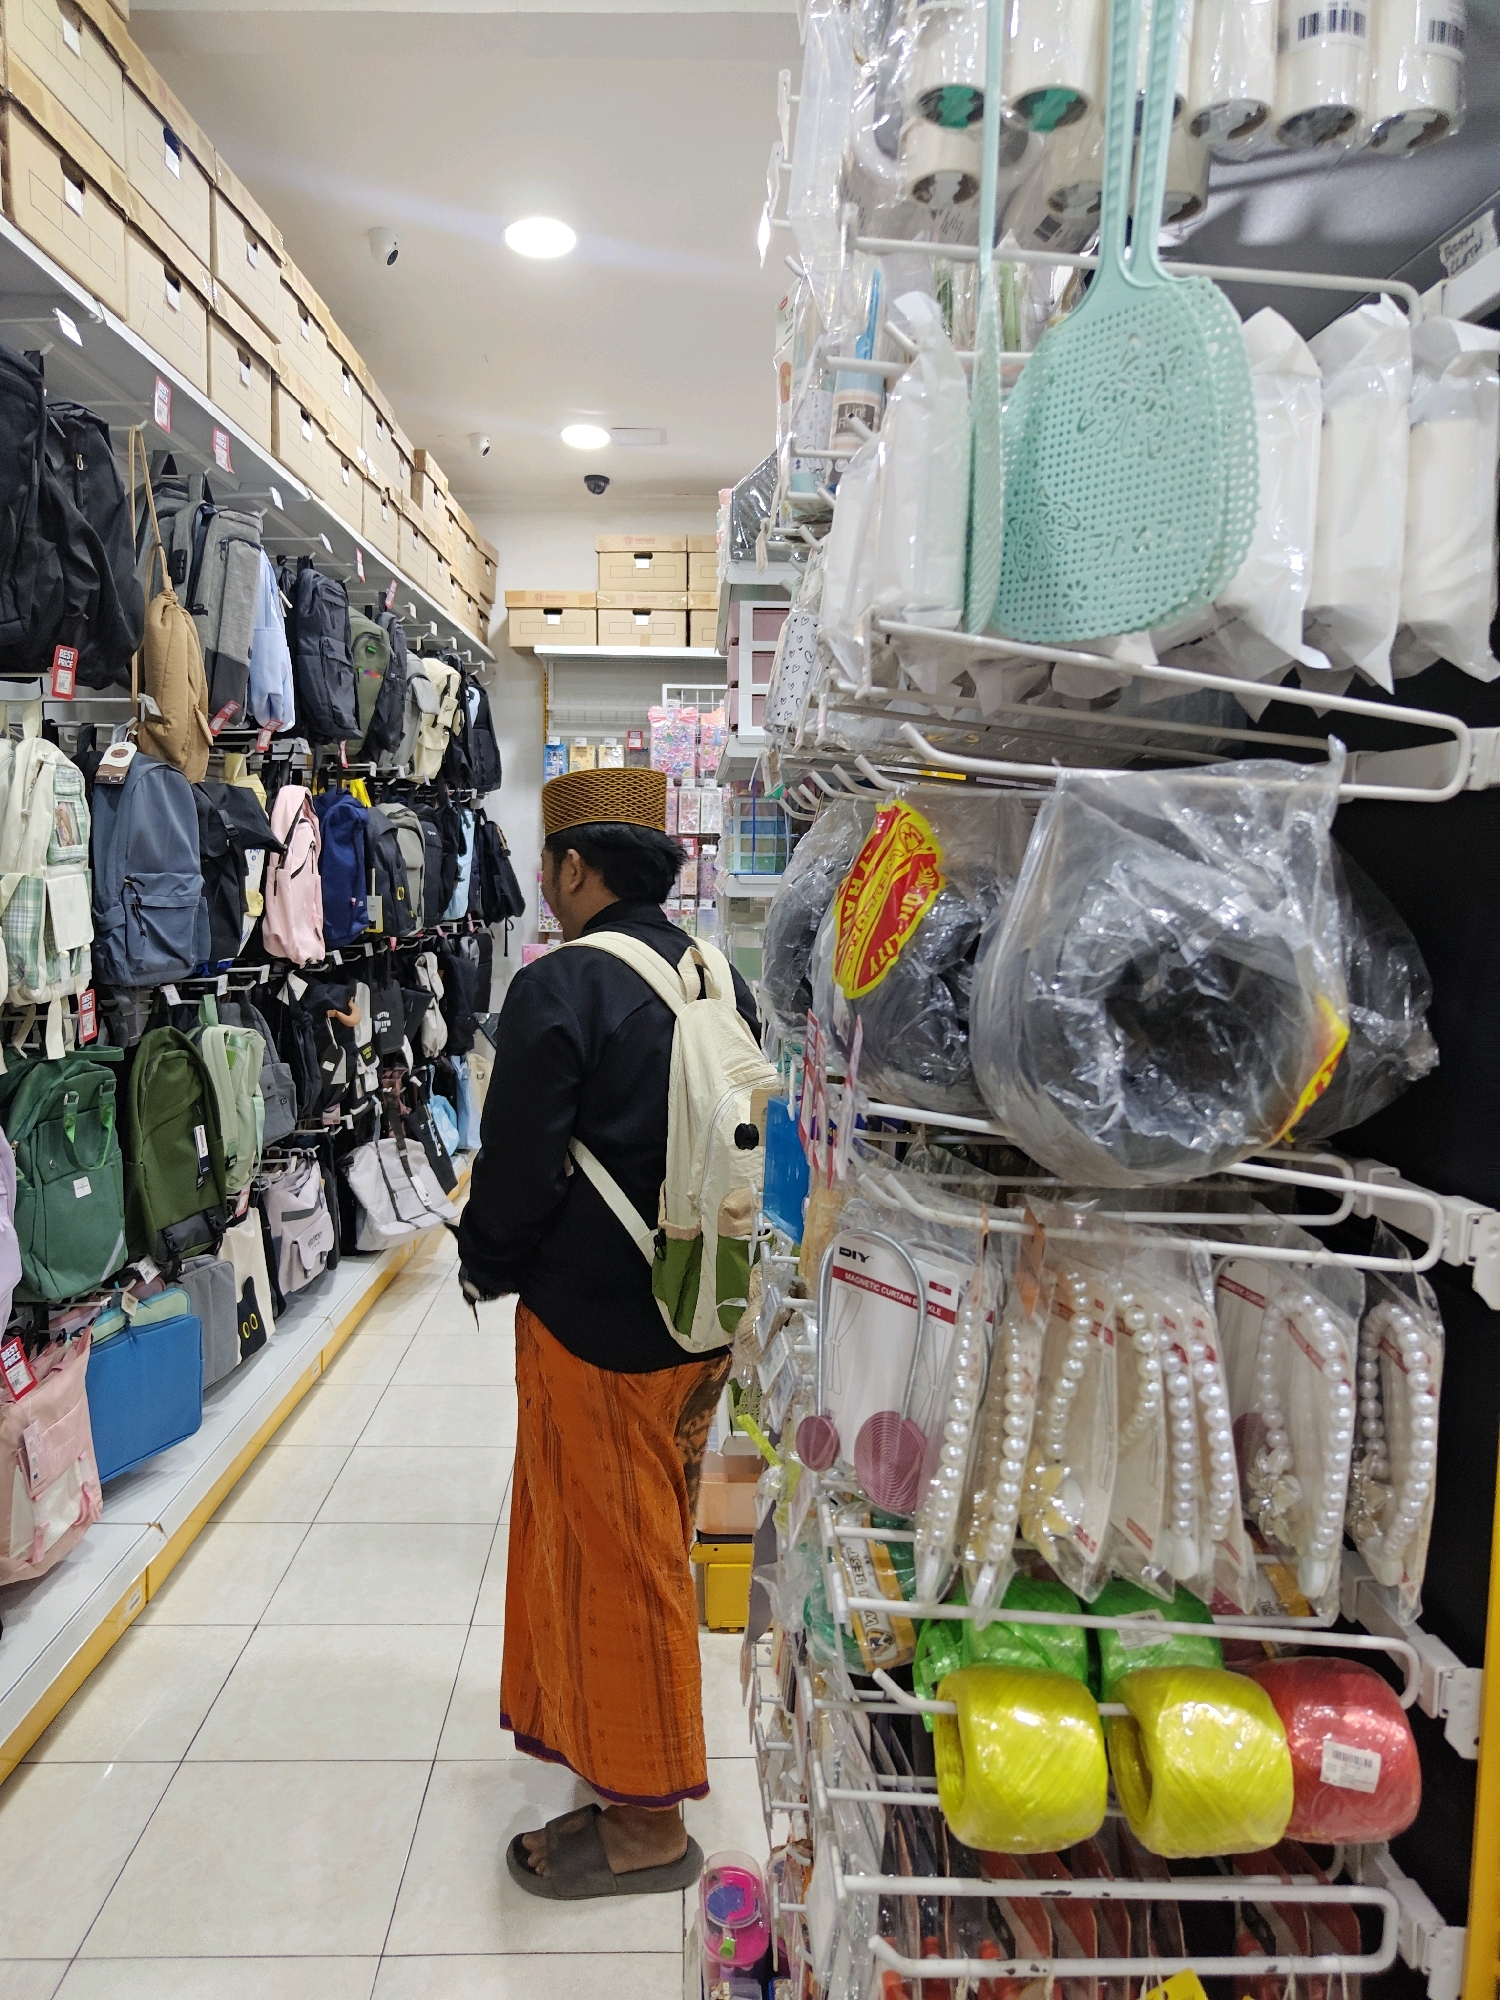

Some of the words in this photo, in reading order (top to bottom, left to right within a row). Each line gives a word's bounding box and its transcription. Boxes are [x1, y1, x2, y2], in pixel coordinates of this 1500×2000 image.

[60, 648, 75, 660] BEST
[58, 657, 73, 669] PRICE
[839, 1246, 870, 1263] DIY
[844, 1272, 881, 1292] MAGNETIC
[881, 1286, 912, 1305] CURTAIN
[913, 1297, 942, 1317] BKLE
[1, 1342, 18, 1360] BEST
[4, 1350, 21, 1370] PRICE
